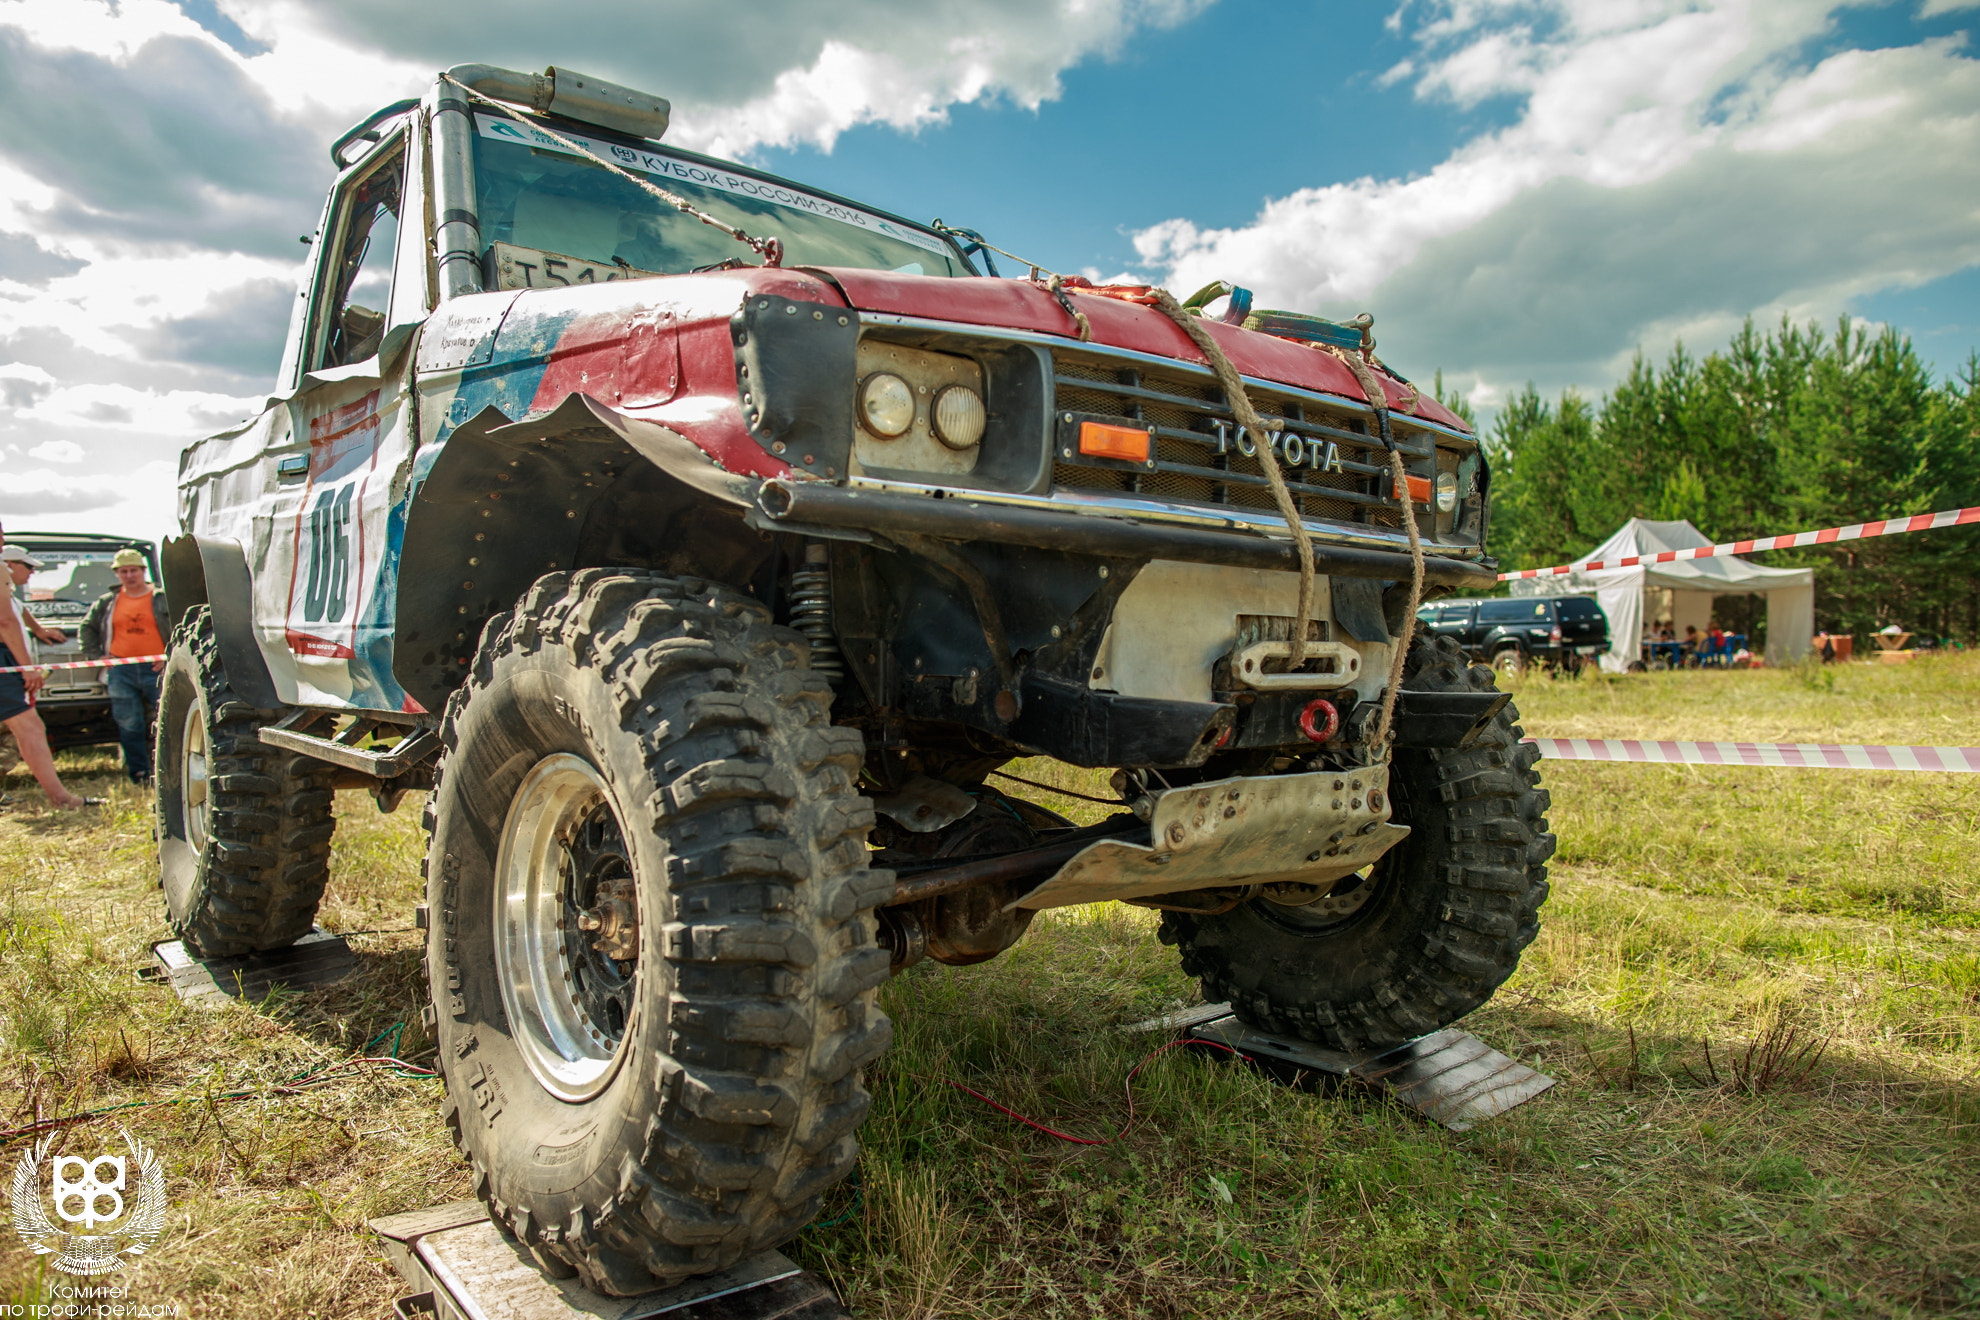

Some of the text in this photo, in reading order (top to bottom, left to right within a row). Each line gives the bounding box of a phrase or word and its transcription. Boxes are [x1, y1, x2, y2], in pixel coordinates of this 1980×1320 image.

[642, 155, 866, 226] КУБОК РОССИИ 2016
[1212, 417, 1342, 474] TOYOTA
